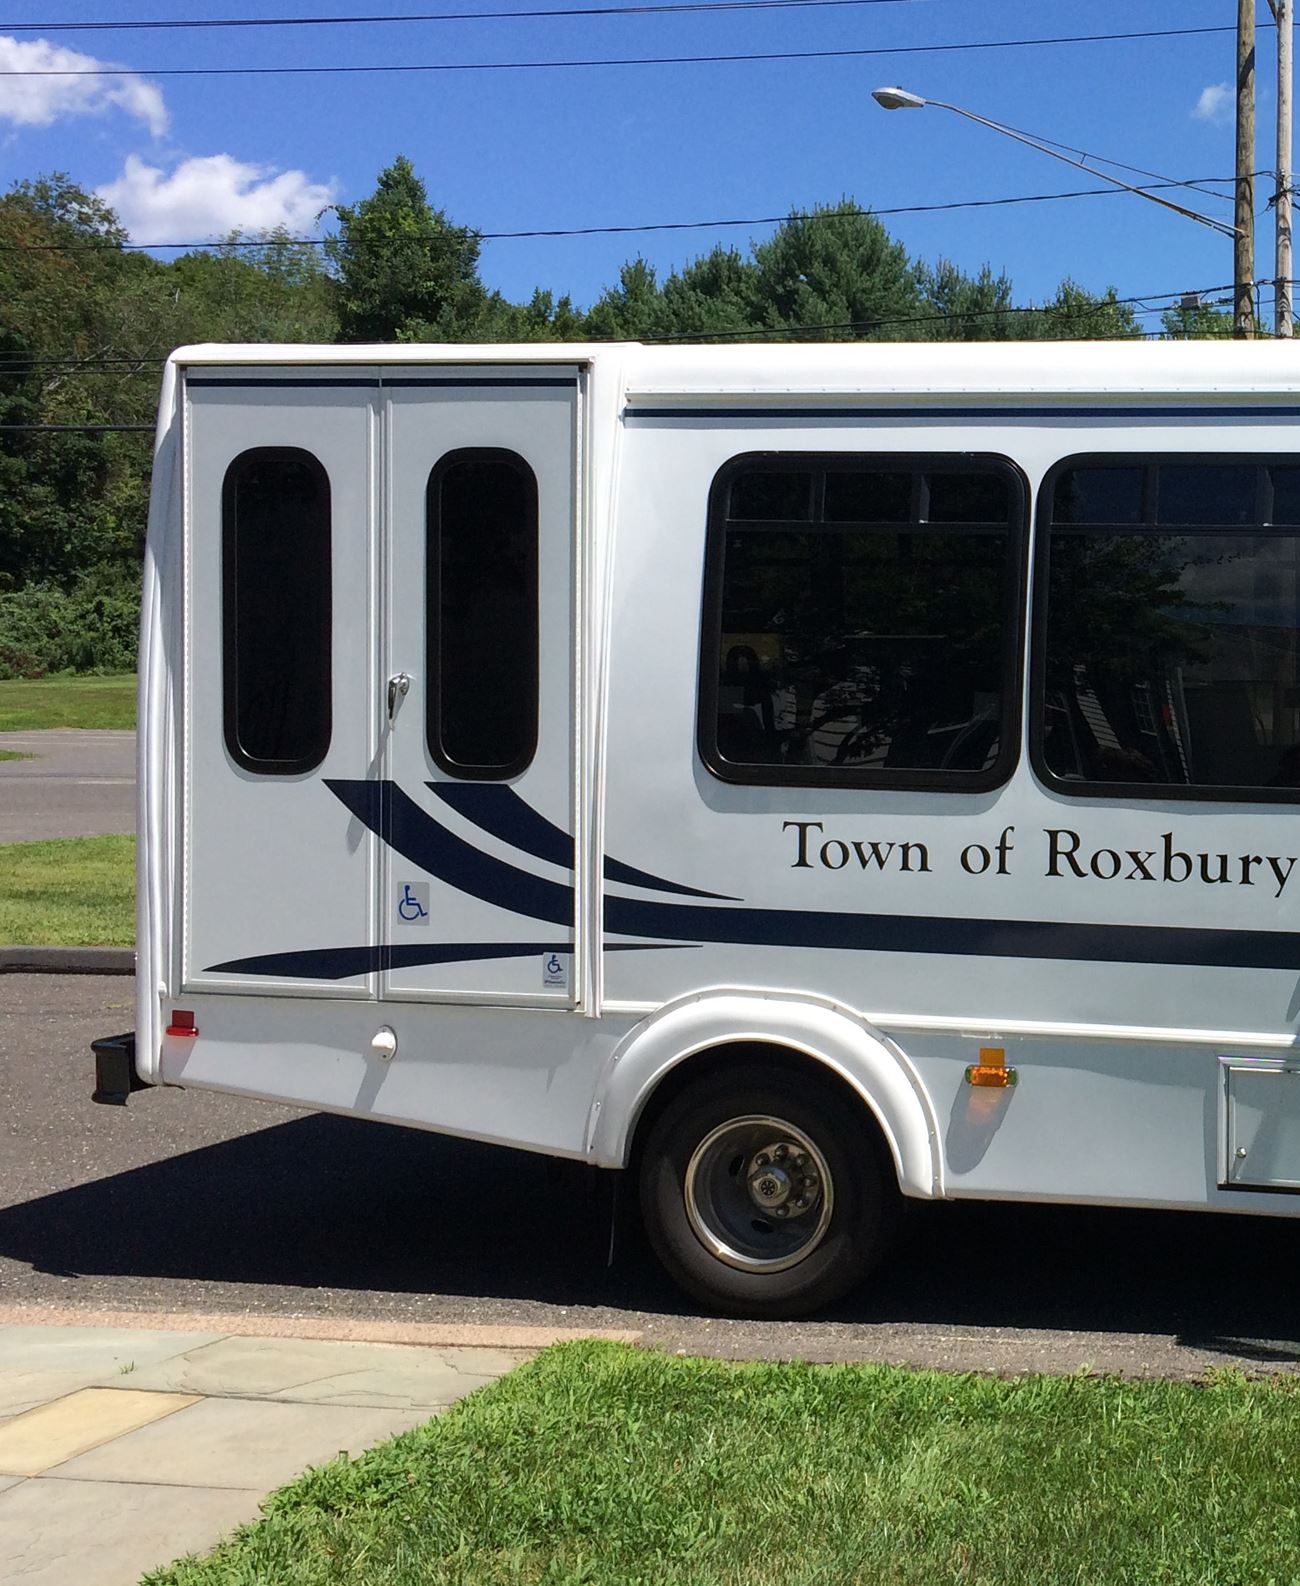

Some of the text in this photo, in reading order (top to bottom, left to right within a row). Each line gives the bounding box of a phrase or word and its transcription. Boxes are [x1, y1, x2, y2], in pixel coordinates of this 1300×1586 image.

[782, 821, 1298, 898] Town of Roxbury
